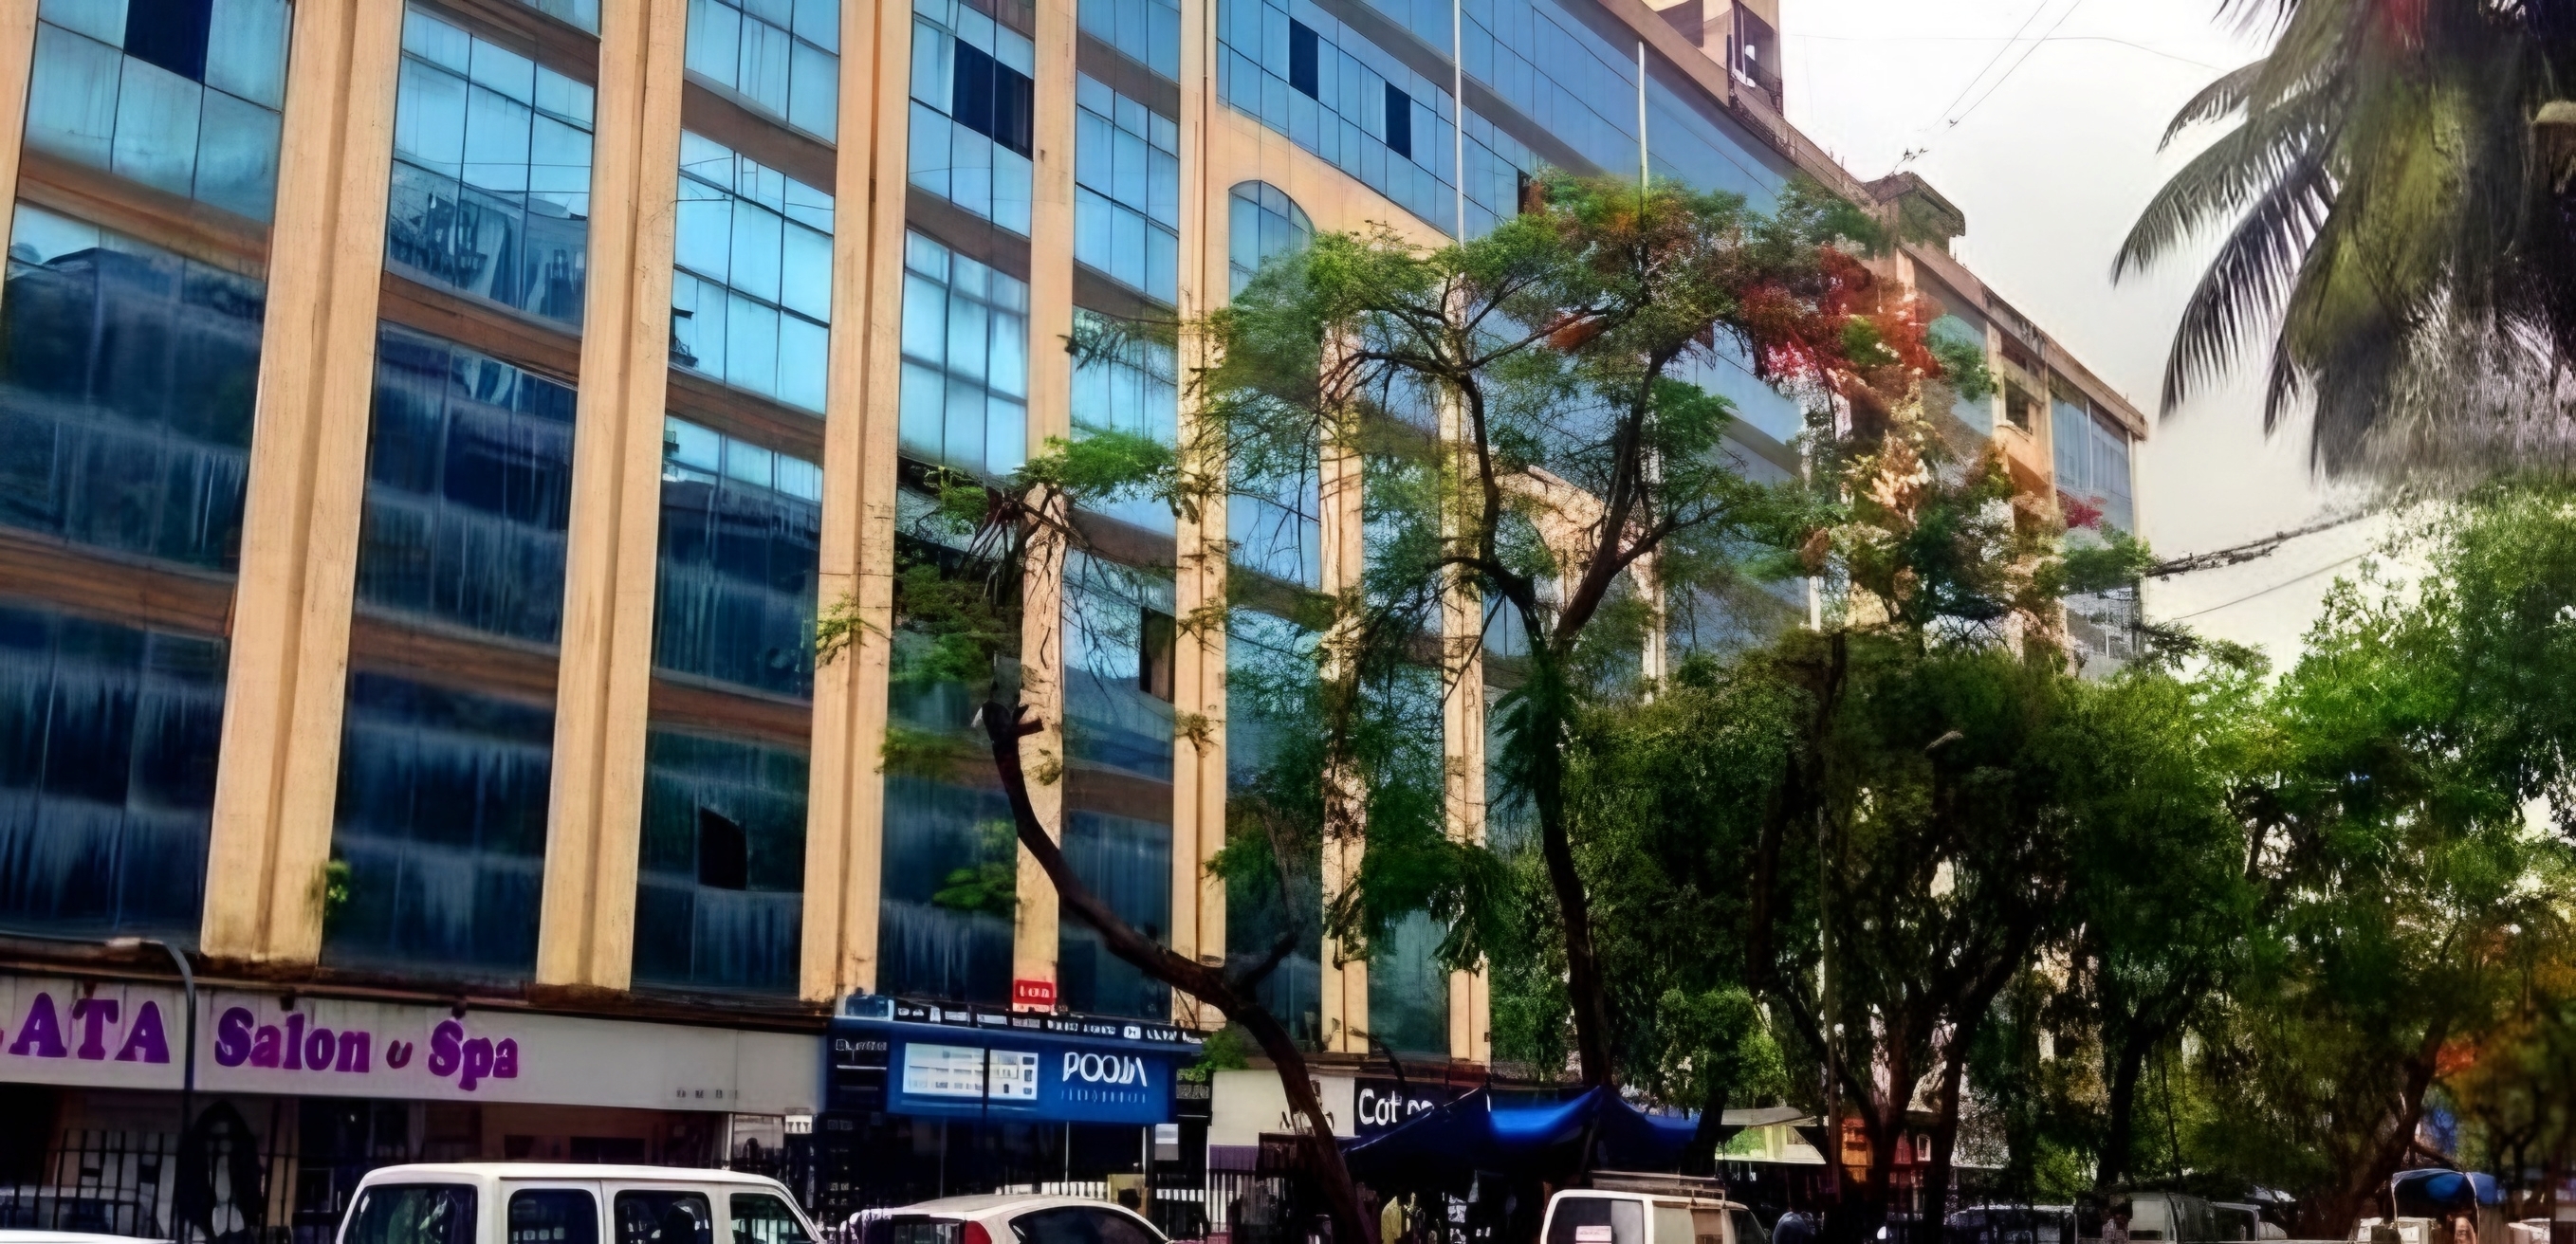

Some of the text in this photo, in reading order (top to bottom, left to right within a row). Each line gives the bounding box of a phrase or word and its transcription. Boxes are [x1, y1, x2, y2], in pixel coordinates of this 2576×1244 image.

[0, 992, 170, 1064] ATA
[214, 1006, 370, 1072] Salon
[429, 1019, 518, 1091] Spa
